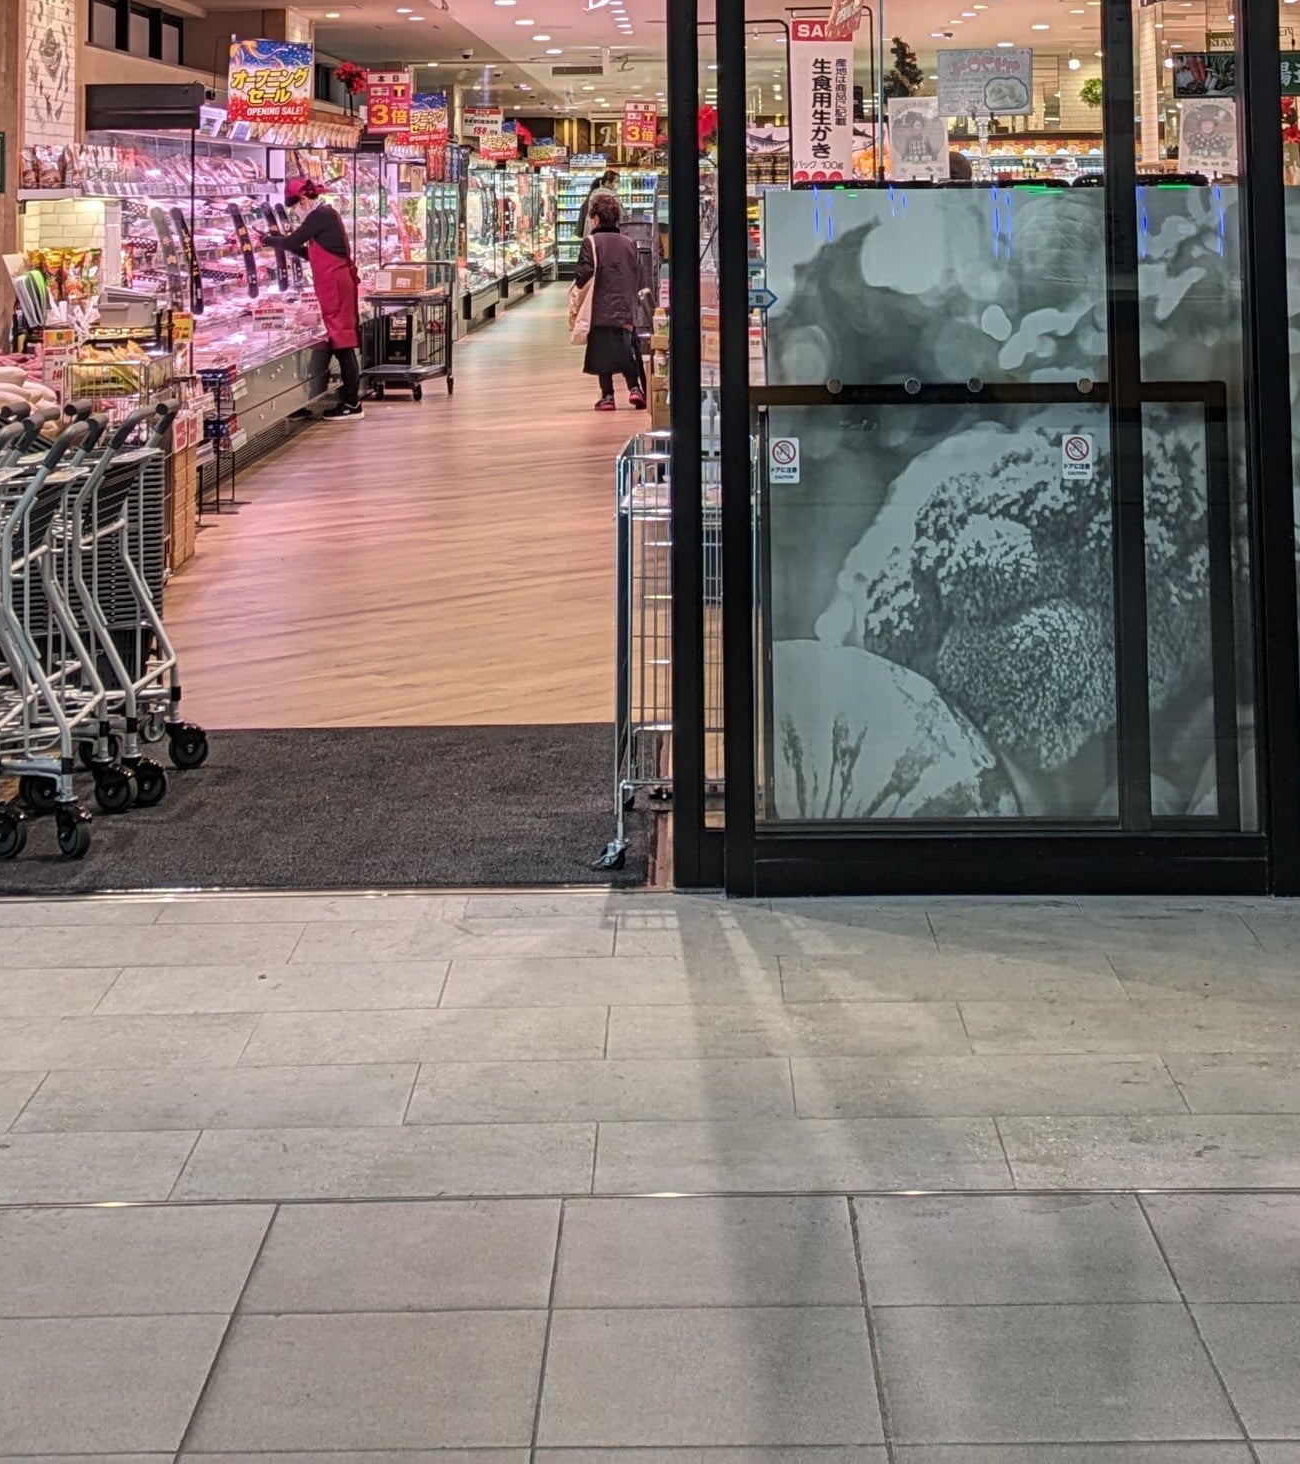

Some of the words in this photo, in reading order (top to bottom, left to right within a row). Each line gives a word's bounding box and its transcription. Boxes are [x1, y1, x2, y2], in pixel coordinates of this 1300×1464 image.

[797, 24, 826, 37] SA
[230, 67, 310, 90] オープニング
[248, 88, 292, 104] セール
[835, 58, 847, 126] 産地は商品に記載
[247, 107, 280, 116] OPENING
[370, 104, 408, 124] 3倍
[412, 109, 447, 123] プニング
[811, 58, 832, 159] 生食用生かき
[821, 161, 844, 170] 100g
